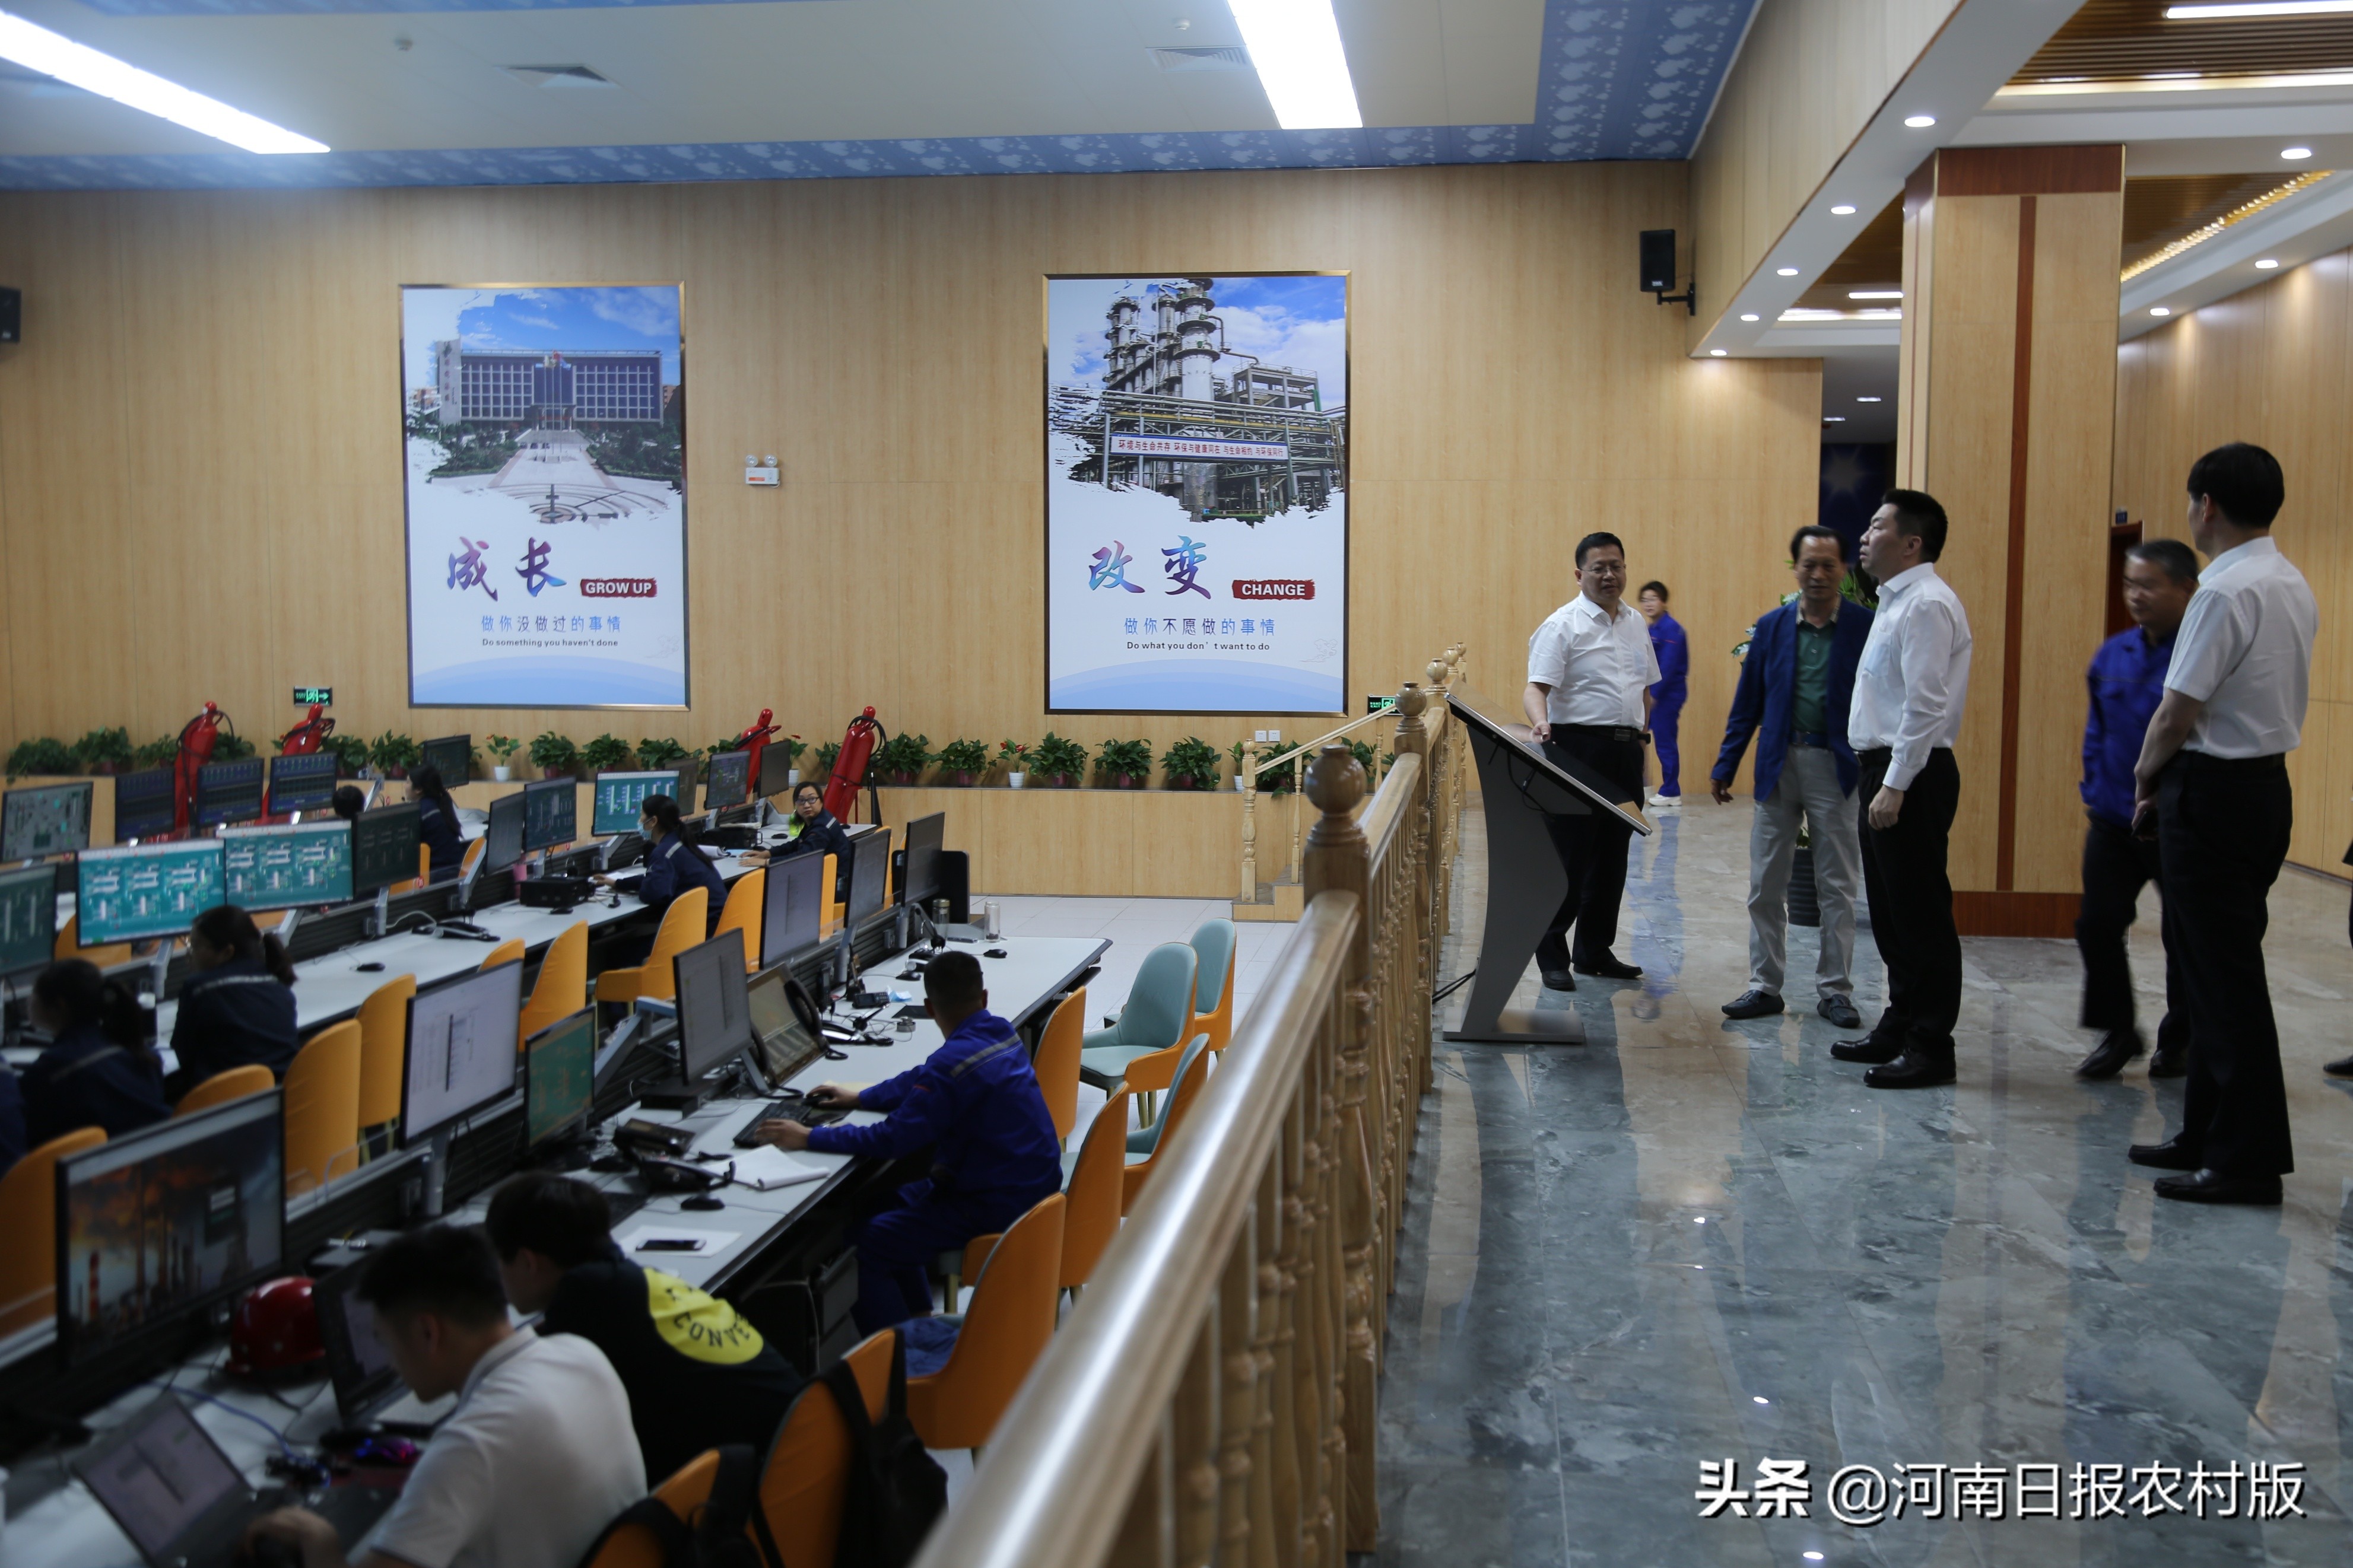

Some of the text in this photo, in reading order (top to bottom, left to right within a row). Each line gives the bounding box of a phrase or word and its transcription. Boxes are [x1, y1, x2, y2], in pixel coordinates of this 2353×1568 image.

[447, 536, 567, 602] 成长
[1088, 535, 1211, 600] 改变
[586, 582, 652, 594] GROW UP
[1241, 584, 1306, 596] CHANGE
[481, 615, 621, 633] 做你没做过的事情
[1124, 618, 1275, 636] 做你不愿做的事情
[496, 639, 542, 647] something
